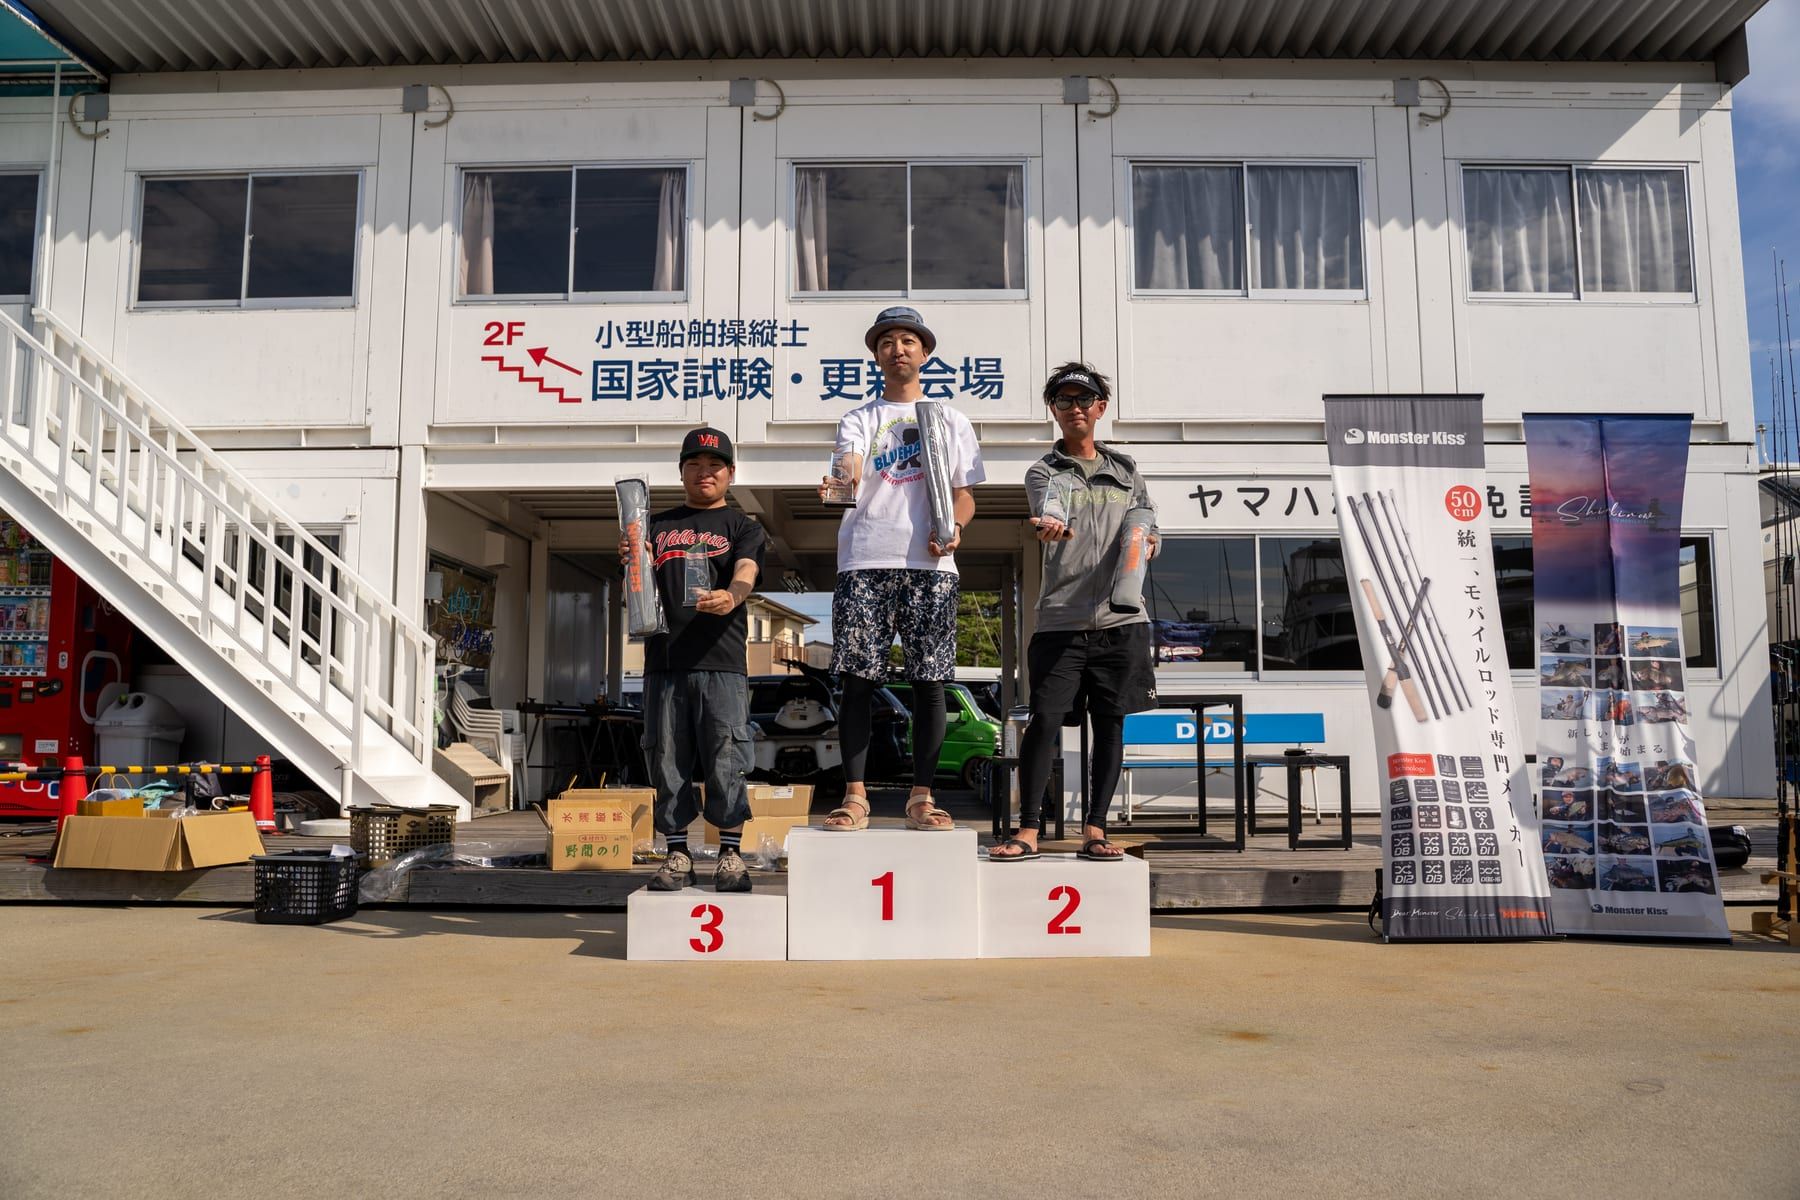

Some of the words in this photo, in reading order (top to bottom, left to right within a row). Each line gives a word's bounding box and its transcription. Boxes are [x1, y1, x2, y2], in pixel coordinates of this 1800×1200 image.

[483, 321, 526, 346] 2F
[594, 318, 810, 349] 小型船舶操縦士
[1367, 430, 1429, 444] Monster
[1432, 431, 1466, 446] Kiss
[873, 440, 921, 471] BLUEHA
[1189, 484, 1337, 518] ヤマハ
[1451, 490, 1476, 508] 50
[1453, 507, 1475, 518] cm
[1457, 528, 1524, 868] 統一、モバイルロッド専門メーカー
[1567, 728, 1630, 745] 新しいが
[1394, 847, 1410, 856] D8
[1424, 846, 1440, 855] D9
[1451, 846, 1469, 855] D10
[1480, 846, 1496, 855] D11
[1395, 875, 1414, 884] D12
[871, 871, 894, 921] 1
[1047, 885, 1082, 934] 2
[1605, 905, 1645, 915] Monster
[1646, 906, 1669, 915] Kiss
[689, 904, 724, 953] 3
